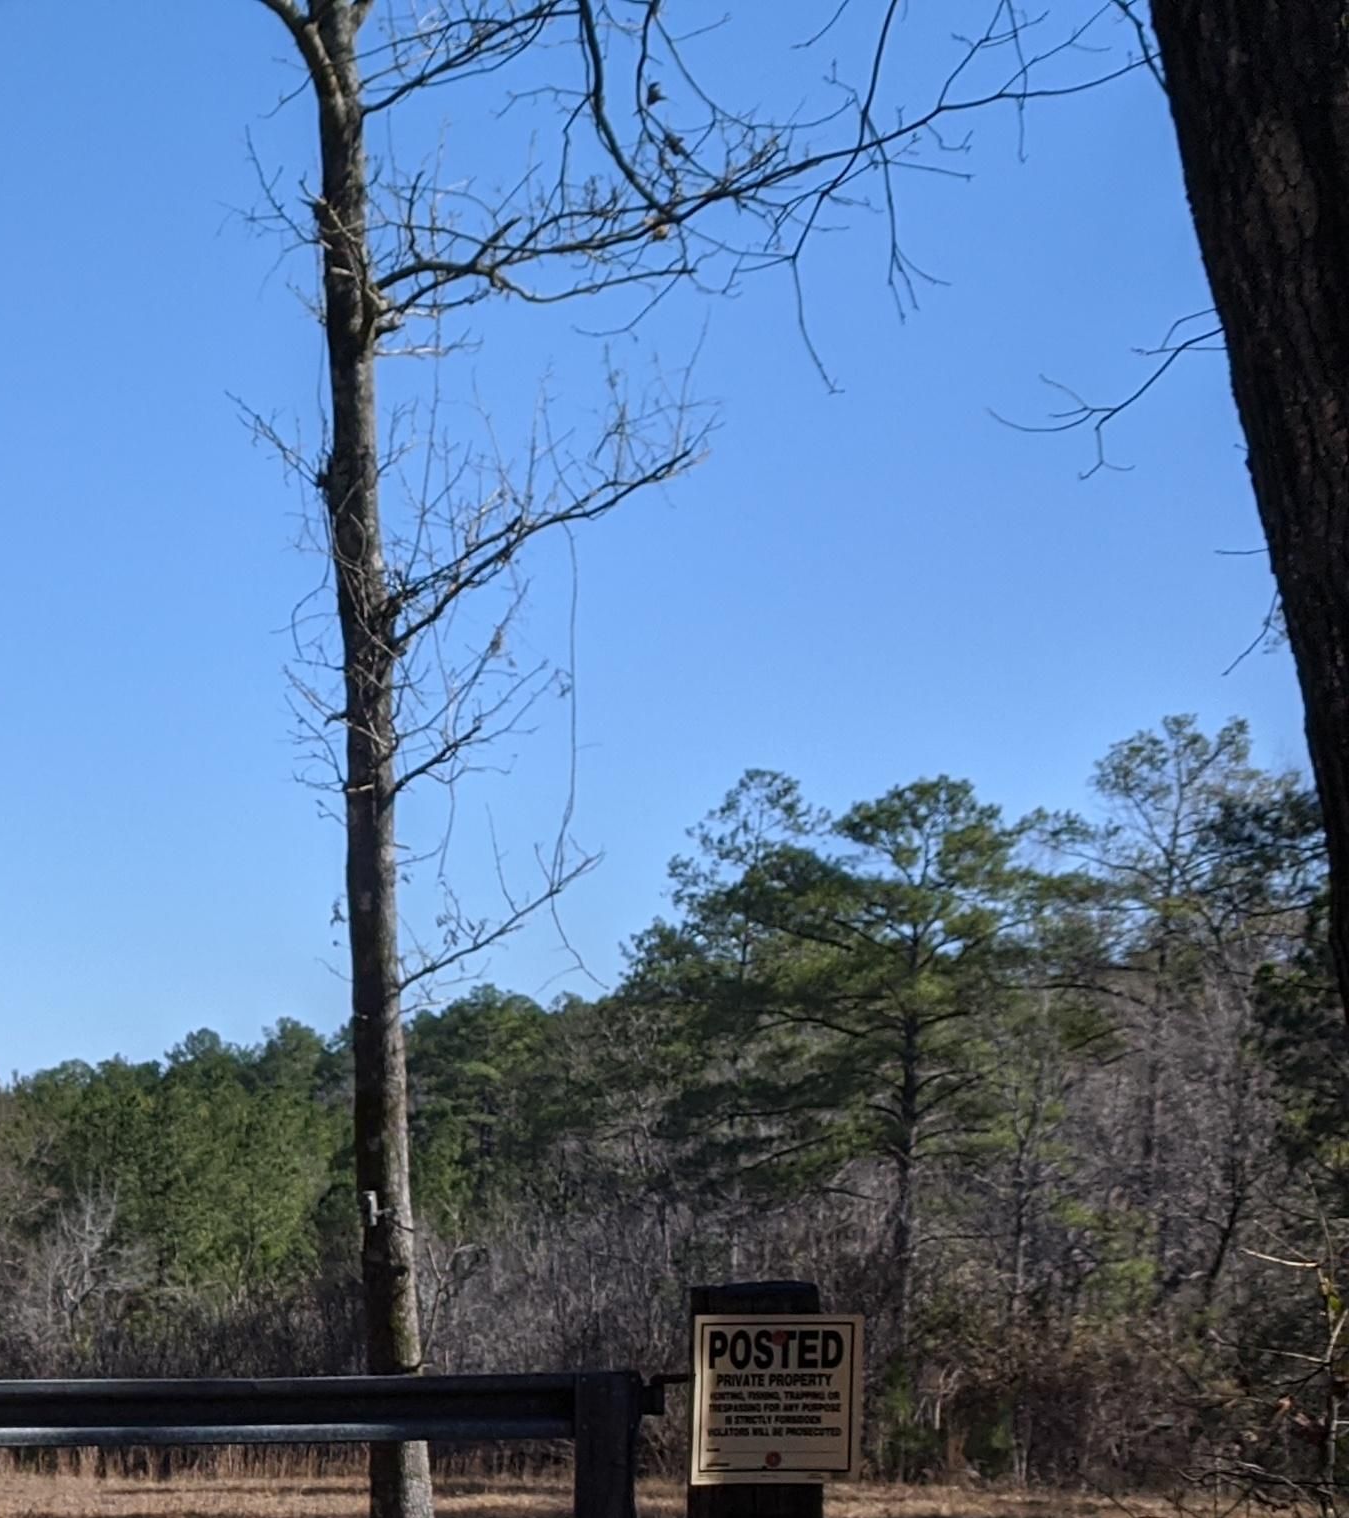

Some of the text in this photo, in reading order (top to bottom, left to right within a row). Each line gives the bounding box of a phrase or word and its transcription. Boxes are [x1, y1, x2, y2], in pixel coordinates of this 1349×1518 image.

[708, 1330, 844, 1369] POSTED
[716, 1373, 834, 1387] PRIVATE PROPERTY
